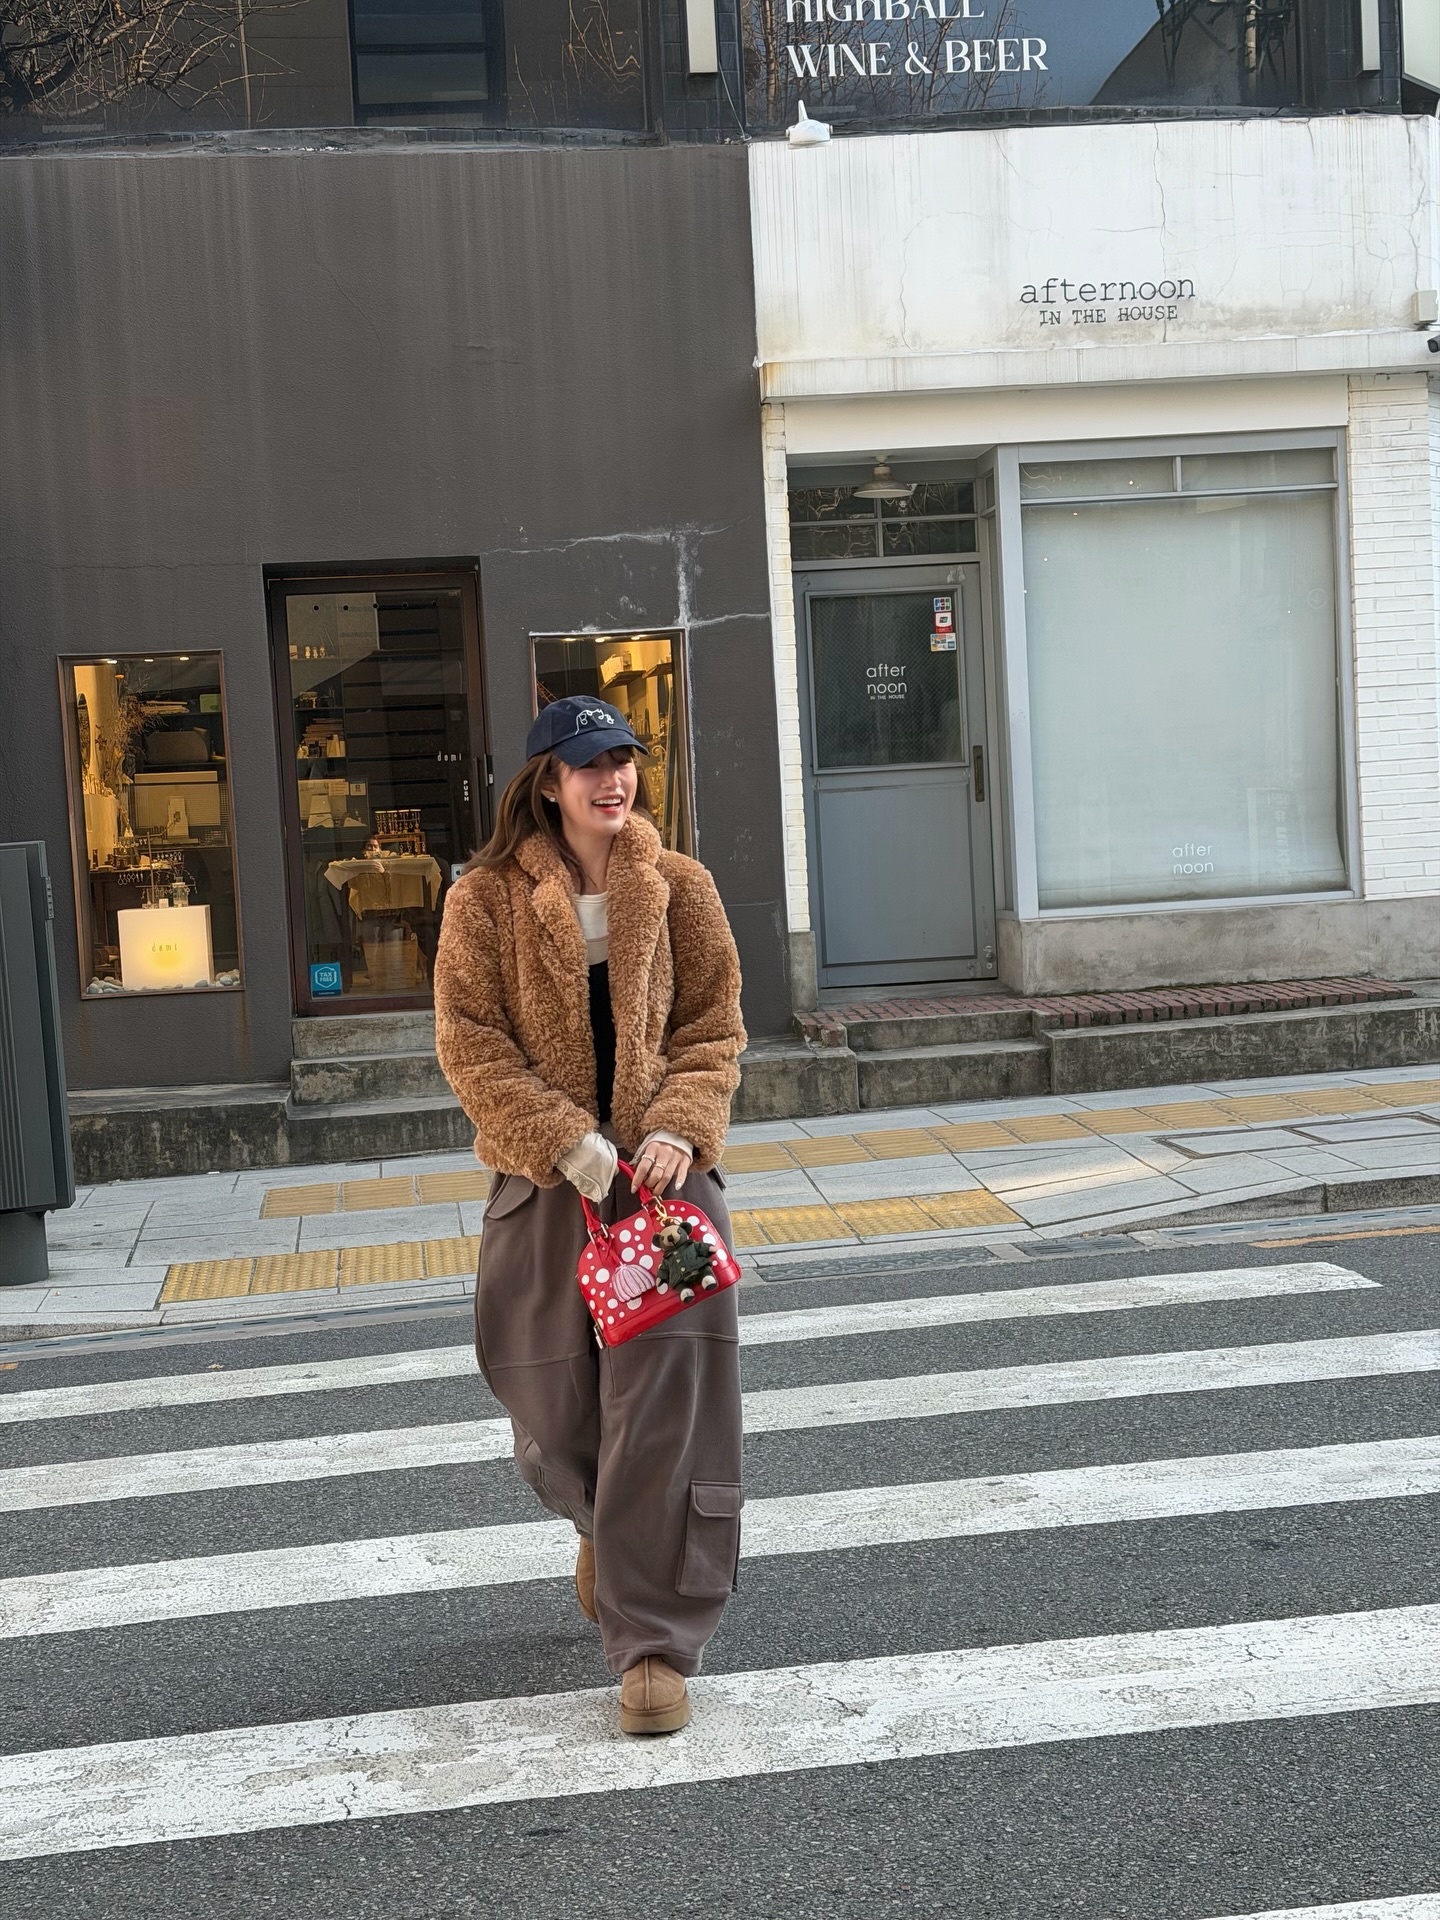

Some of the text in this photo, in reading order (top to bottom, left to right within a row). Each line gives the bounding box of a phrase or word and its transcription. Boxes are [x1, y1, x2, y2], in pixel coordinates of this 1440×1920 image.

[785, 37, 1049, 78] WINE & BEER
[1020, 278, 1196, 304] afternoon
[1039, 305, 1178, 326] IN THE HOUSE
[866, 663, 906, 678] after
[867, 682, 908, 695] noon
[1172, 843, 1213, 858] after
[1173, 862, 1214, 875] noon
